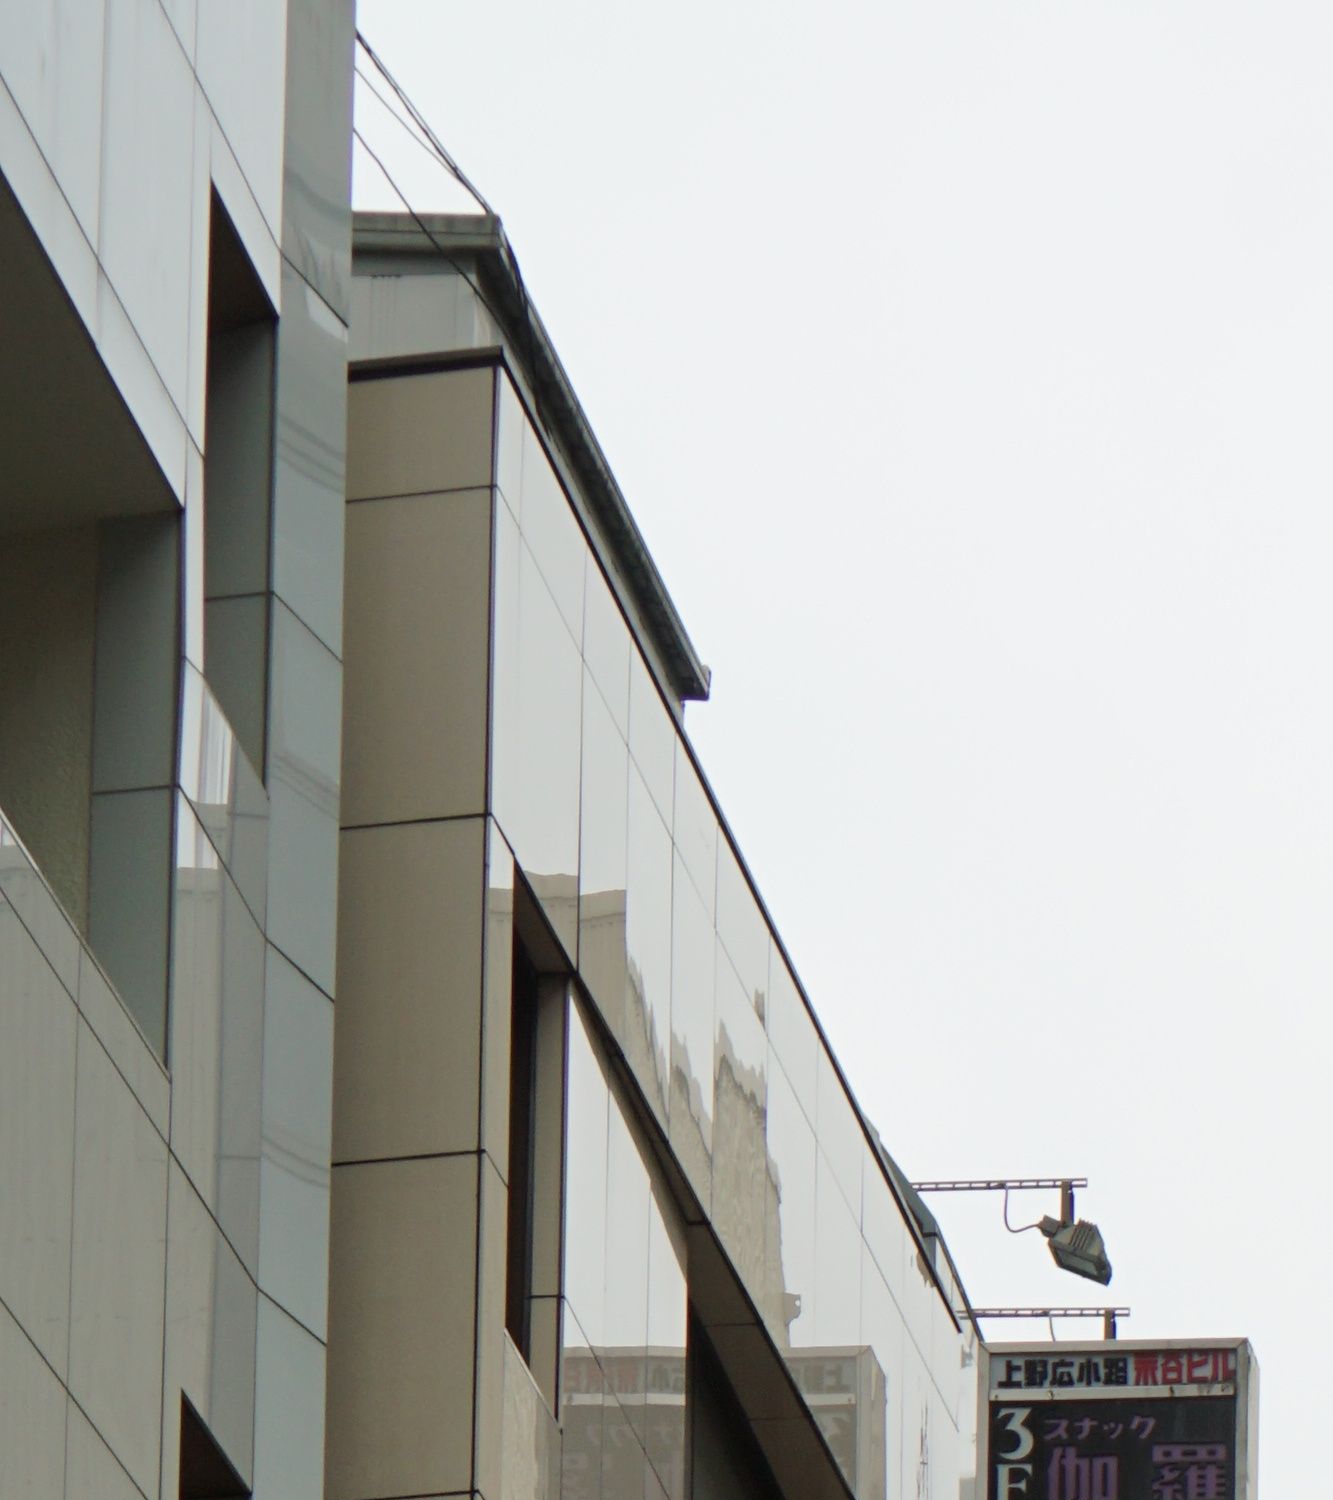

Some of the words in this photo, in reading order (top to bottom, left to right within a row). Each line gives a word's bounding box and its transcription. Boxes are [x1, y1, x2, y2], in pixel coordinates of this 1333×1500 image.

[998, 1357, 1128, 1389] 上野広小路
[1043, 1415, 1156, 1440] スナック
